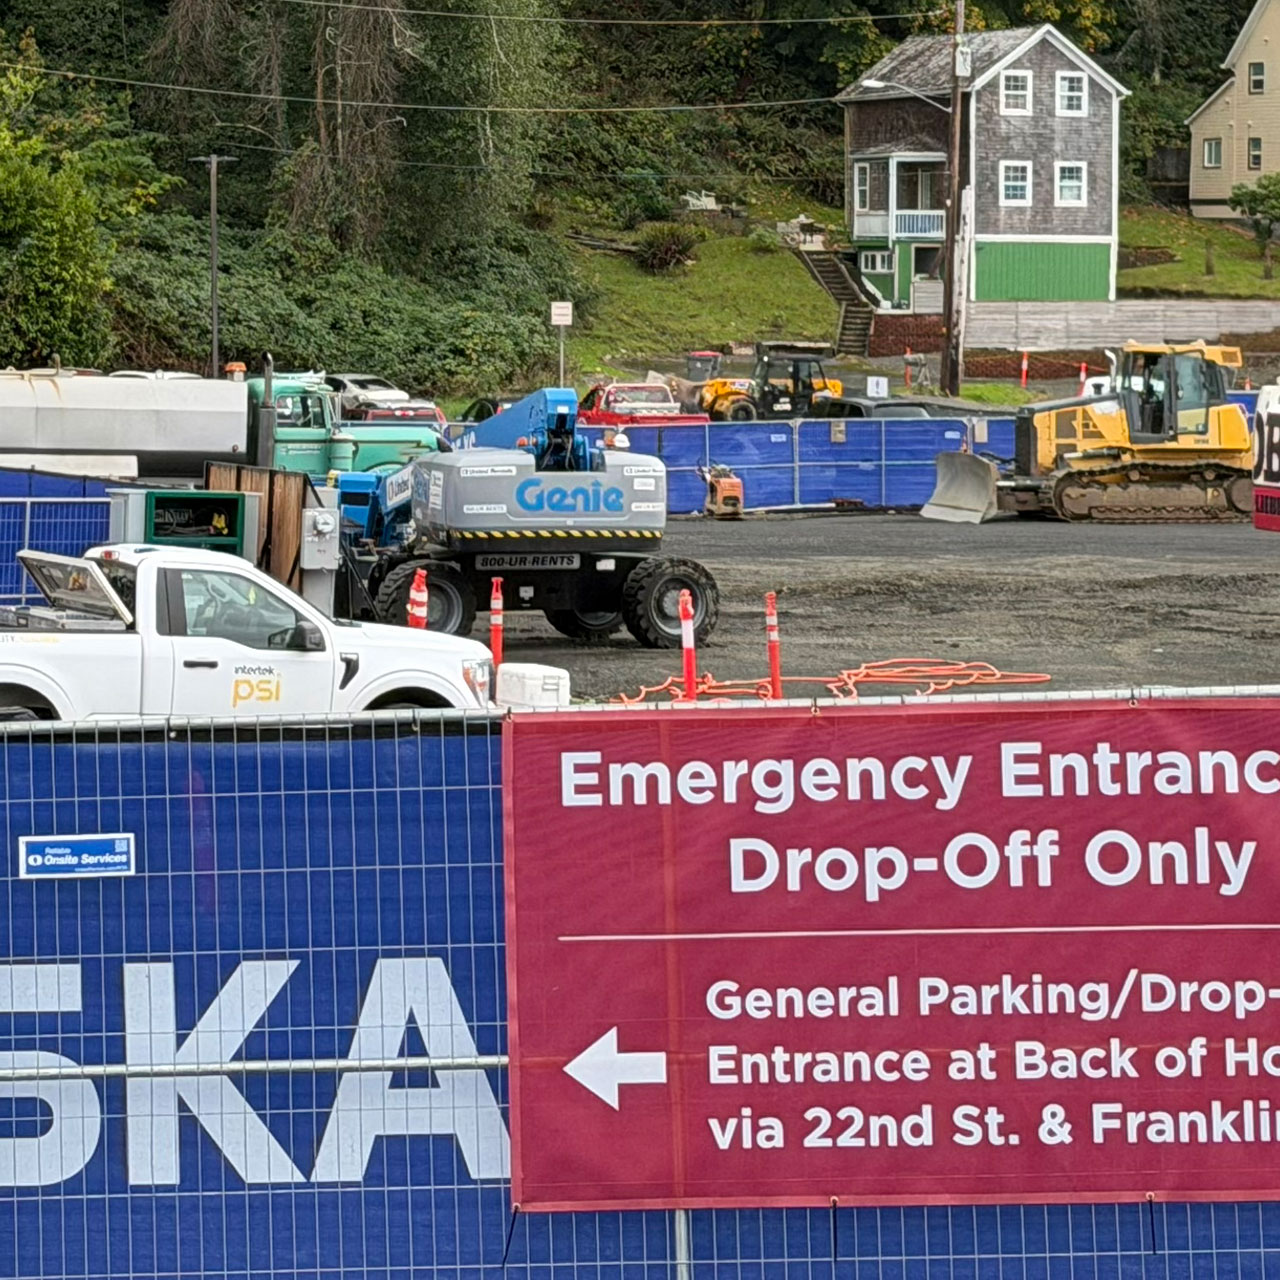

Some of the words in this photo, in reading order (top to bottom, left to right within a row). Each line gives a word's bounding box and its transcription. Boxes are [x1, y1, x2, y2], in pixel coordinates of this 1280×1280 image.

[515, 477, 625, 512] Genie
[480, 555, 575, 567] 800-UR-RENTS
[232, 672, 282, 708] psi
[234, 665, 275, 676] intertek
[560, 751, 973, 814] Emergency
[80, 852, 128, 865] Services
[729, 829, 1060, 902] Drop-Off
[1084, 826, 1258, 896] Only
[706, 975, 899, 1020] General
[708, 1045, 931, 1084] Entrance
[948, 1042, 997, 1081] at
[1015, 1037, 1139, 1080] Back
[1154, 1036, 1208, 1078] of
[708, 1107, 785, 1150] via
[803, 1104, 933, 1148] 22nd
[952, 1104, 1020, 1147] St.
[1038, 1103, 1074, 1145] &
